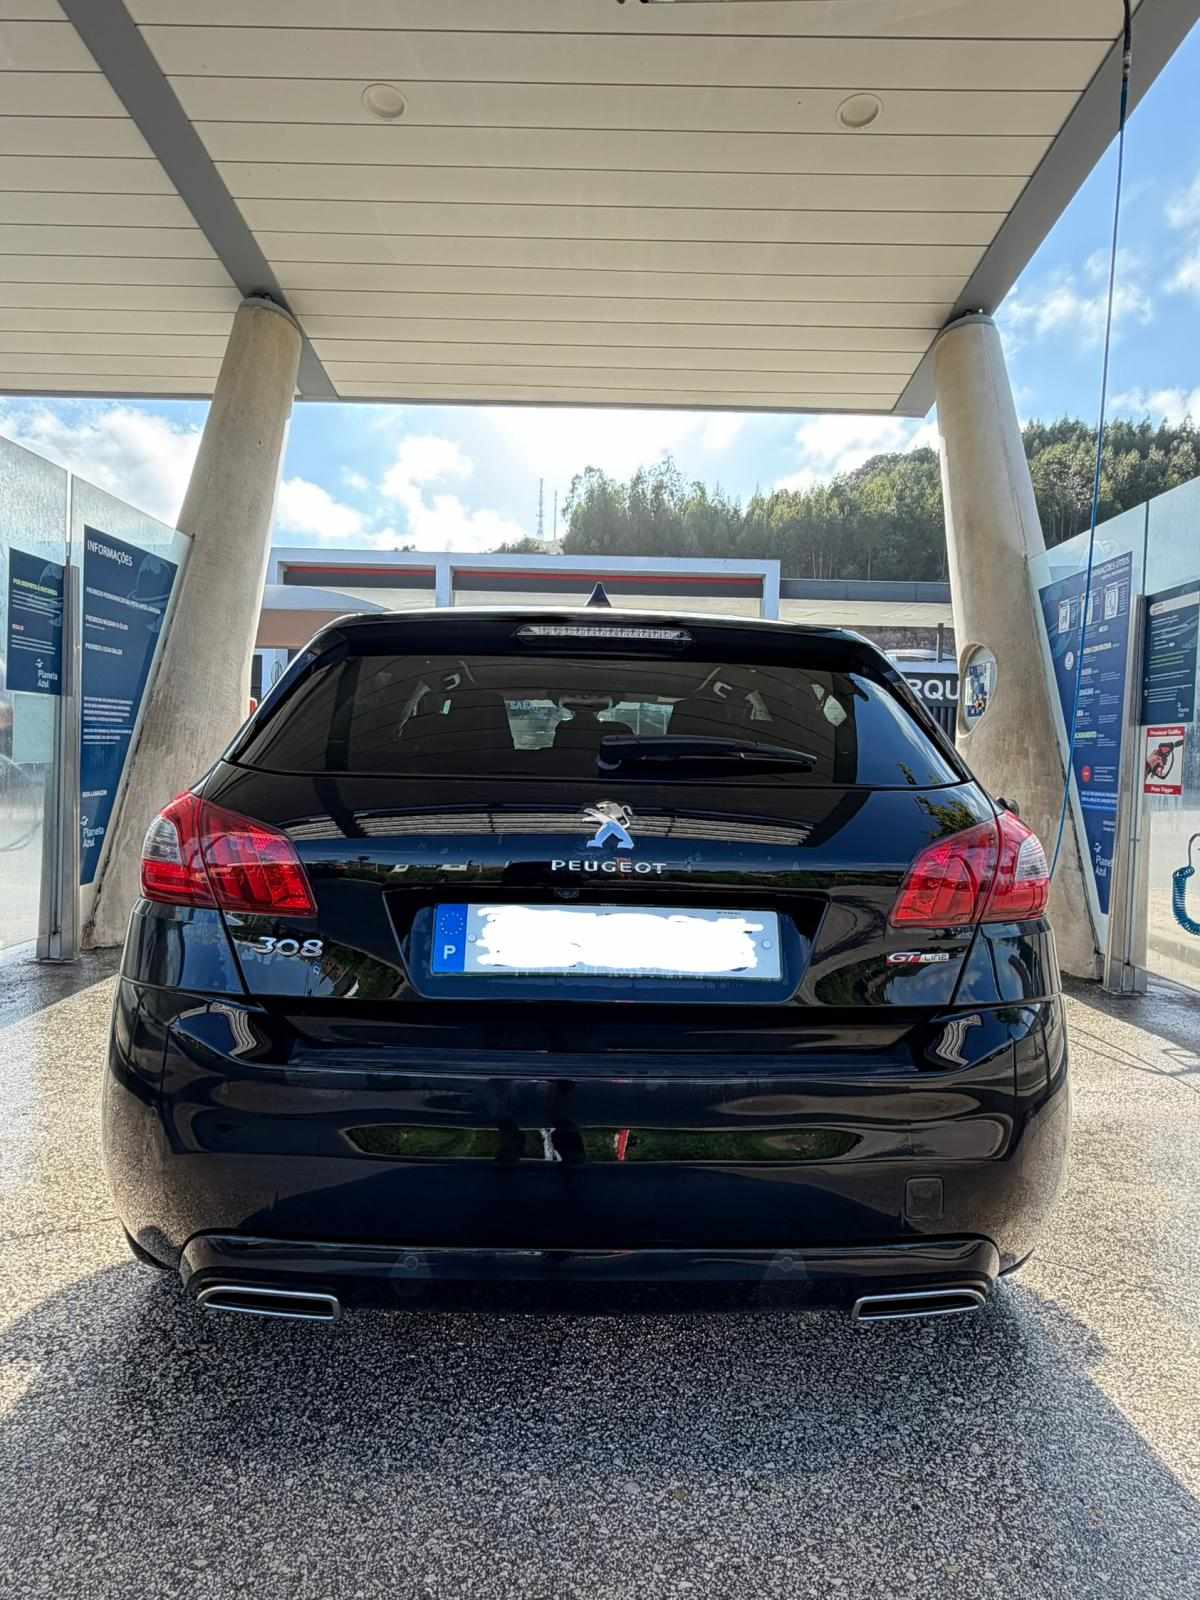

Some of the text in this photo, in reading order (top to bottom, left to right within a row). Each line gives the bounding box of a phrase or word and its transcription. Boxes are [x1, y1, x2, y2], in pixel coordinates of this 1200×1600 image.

[87, 539, 133, 567] INFORMAÇÕES
[38, 670, 58, 681] Planeta
[551, 859, 667, 874] PEUGEOT
[253, 936, 324, 957] 308
[443, 944, 456, 960] P
